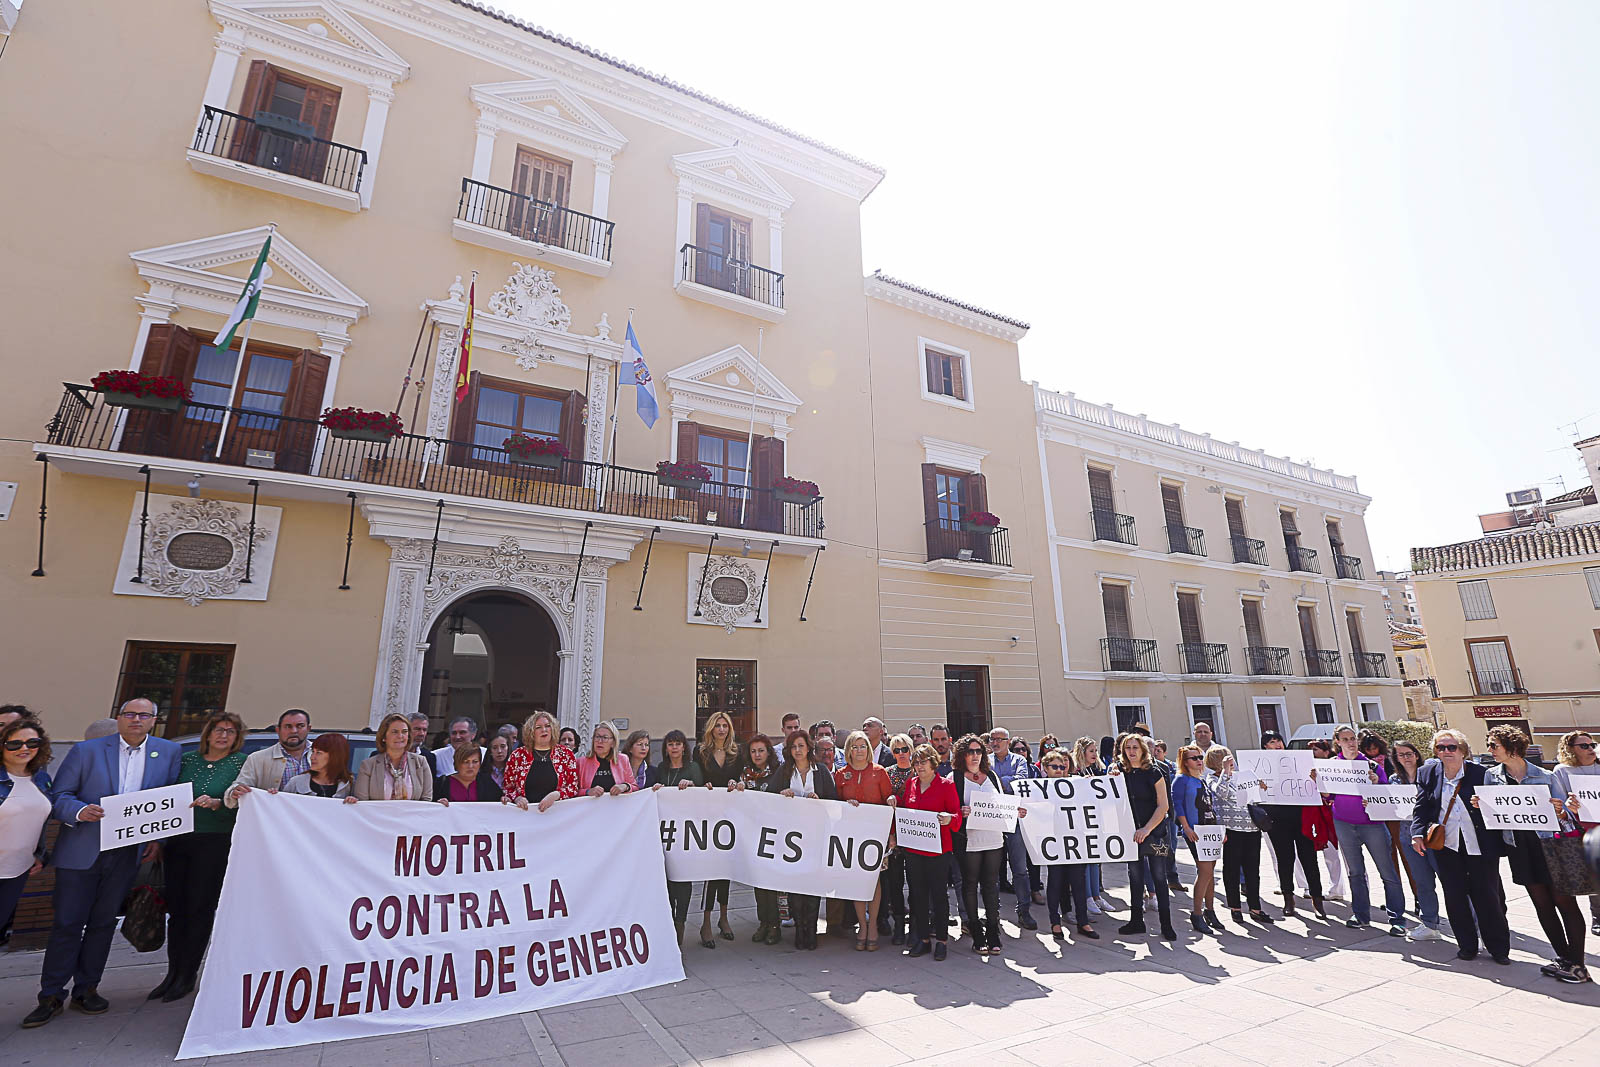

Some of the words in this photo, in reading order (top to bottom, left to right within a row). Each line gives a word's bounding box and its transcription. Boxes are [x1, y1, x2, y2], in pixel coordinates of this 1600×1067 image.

[1248, 756, 1272, 774] YO
[1280, 756, 1298, 774] SI
[1343, 768, 1368, 776] ABUSO,
[1017, 779, 1075, 799] #YO
[1090, 778, 1120, 799] SI
[1281, 778, 1314, 797] CREO
[1330, 776, 1366, 784] VIOLACIÓN
[1495, 796, 1521, 805] #YO
[1525, 796, 1537, 805] SI
[1579, 790, 1600, 800] #N
[124, 802, 156, 817] #YO
[161, 798, 174, 810] SI
[917, 821, 938, 830] ABUSO,
[1060, 806, 1098, 829] TE
[1493, 814, 1510, 823] TE
[1514, 814, 1548, 824] CREO
[115, 827, 134, 839] TE
[140, 817, 182, 834] CREO
[908, 828, 936, 839] VIOLACIÓN
[660, 820, 736, 851] #NO
[757, 827, 803, 862] ES
[828, 836, 883, 871] NO
[1203, 834, 1216, 842] #YO
[395, 832, 526, 876] MOTRIL
[1041, 835, 1124, 860] CREO
[1202, 848, 1211, 856] TE
[349, 889, 510, 941] CONTRA
[523, 879, 568, 921] LA
[241, 953, 458, 1029] VIOLENCIA
[474, 946, 516, 998] DE
[527, 924, 649, 986] GENERO
